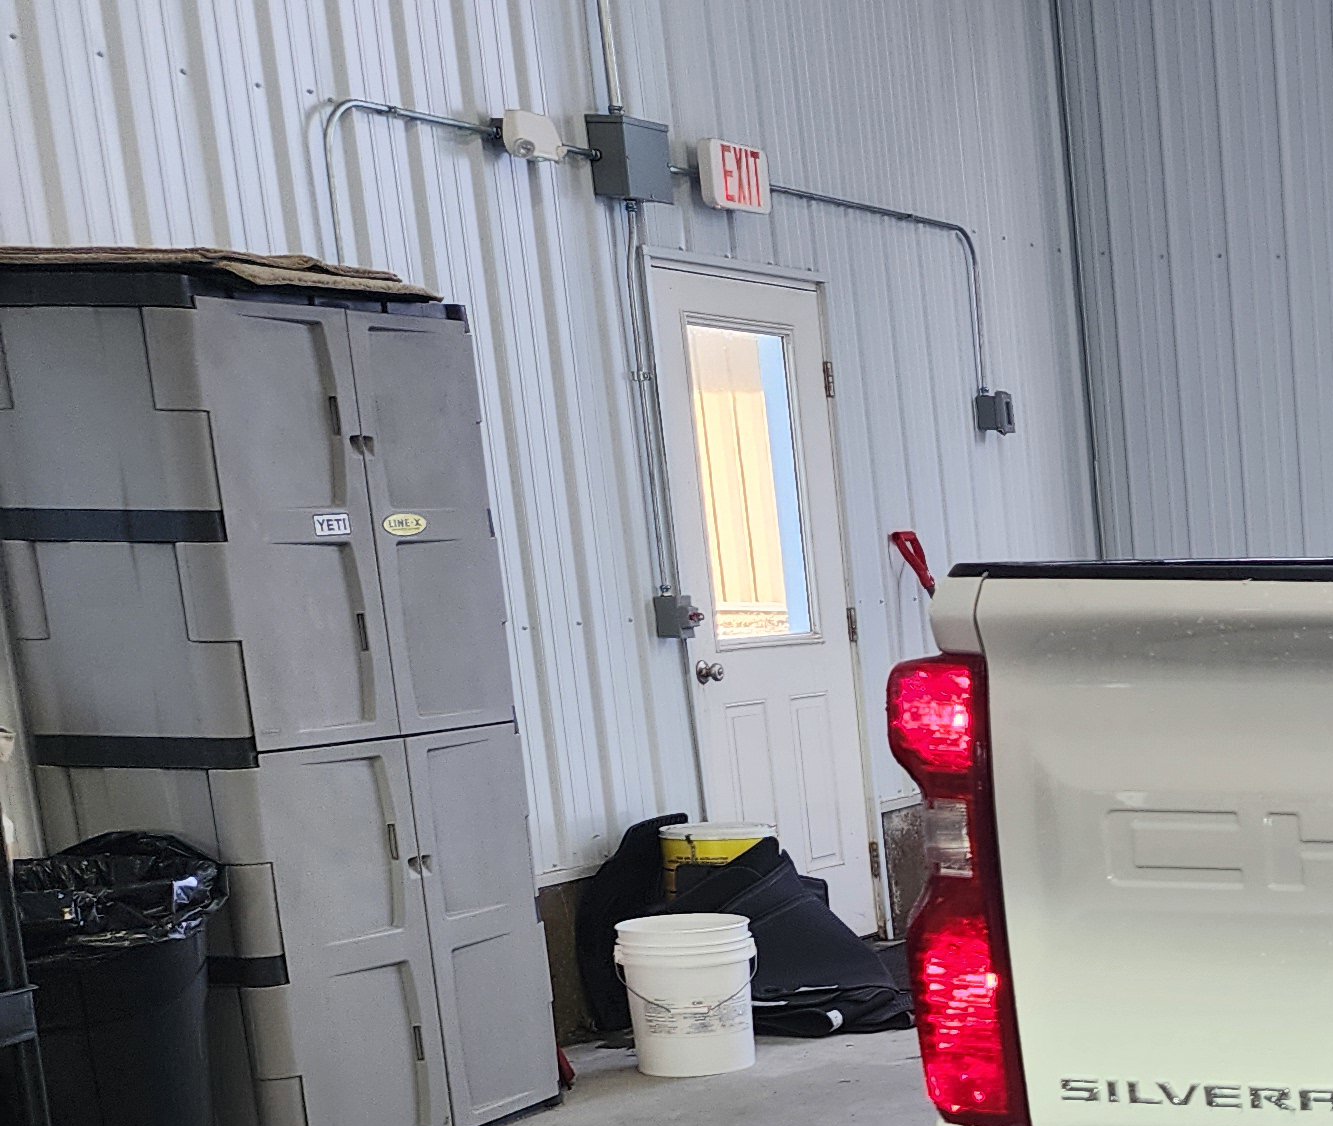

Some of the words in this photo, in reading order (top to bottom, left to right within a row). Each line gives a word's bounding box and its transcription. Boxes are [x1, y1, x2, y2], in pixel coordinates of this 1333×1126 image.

[720, 144, 761, 207] EXIT
[316, 517, 347, 532] YETI
[388, 518, 422, 528] LINE-X
